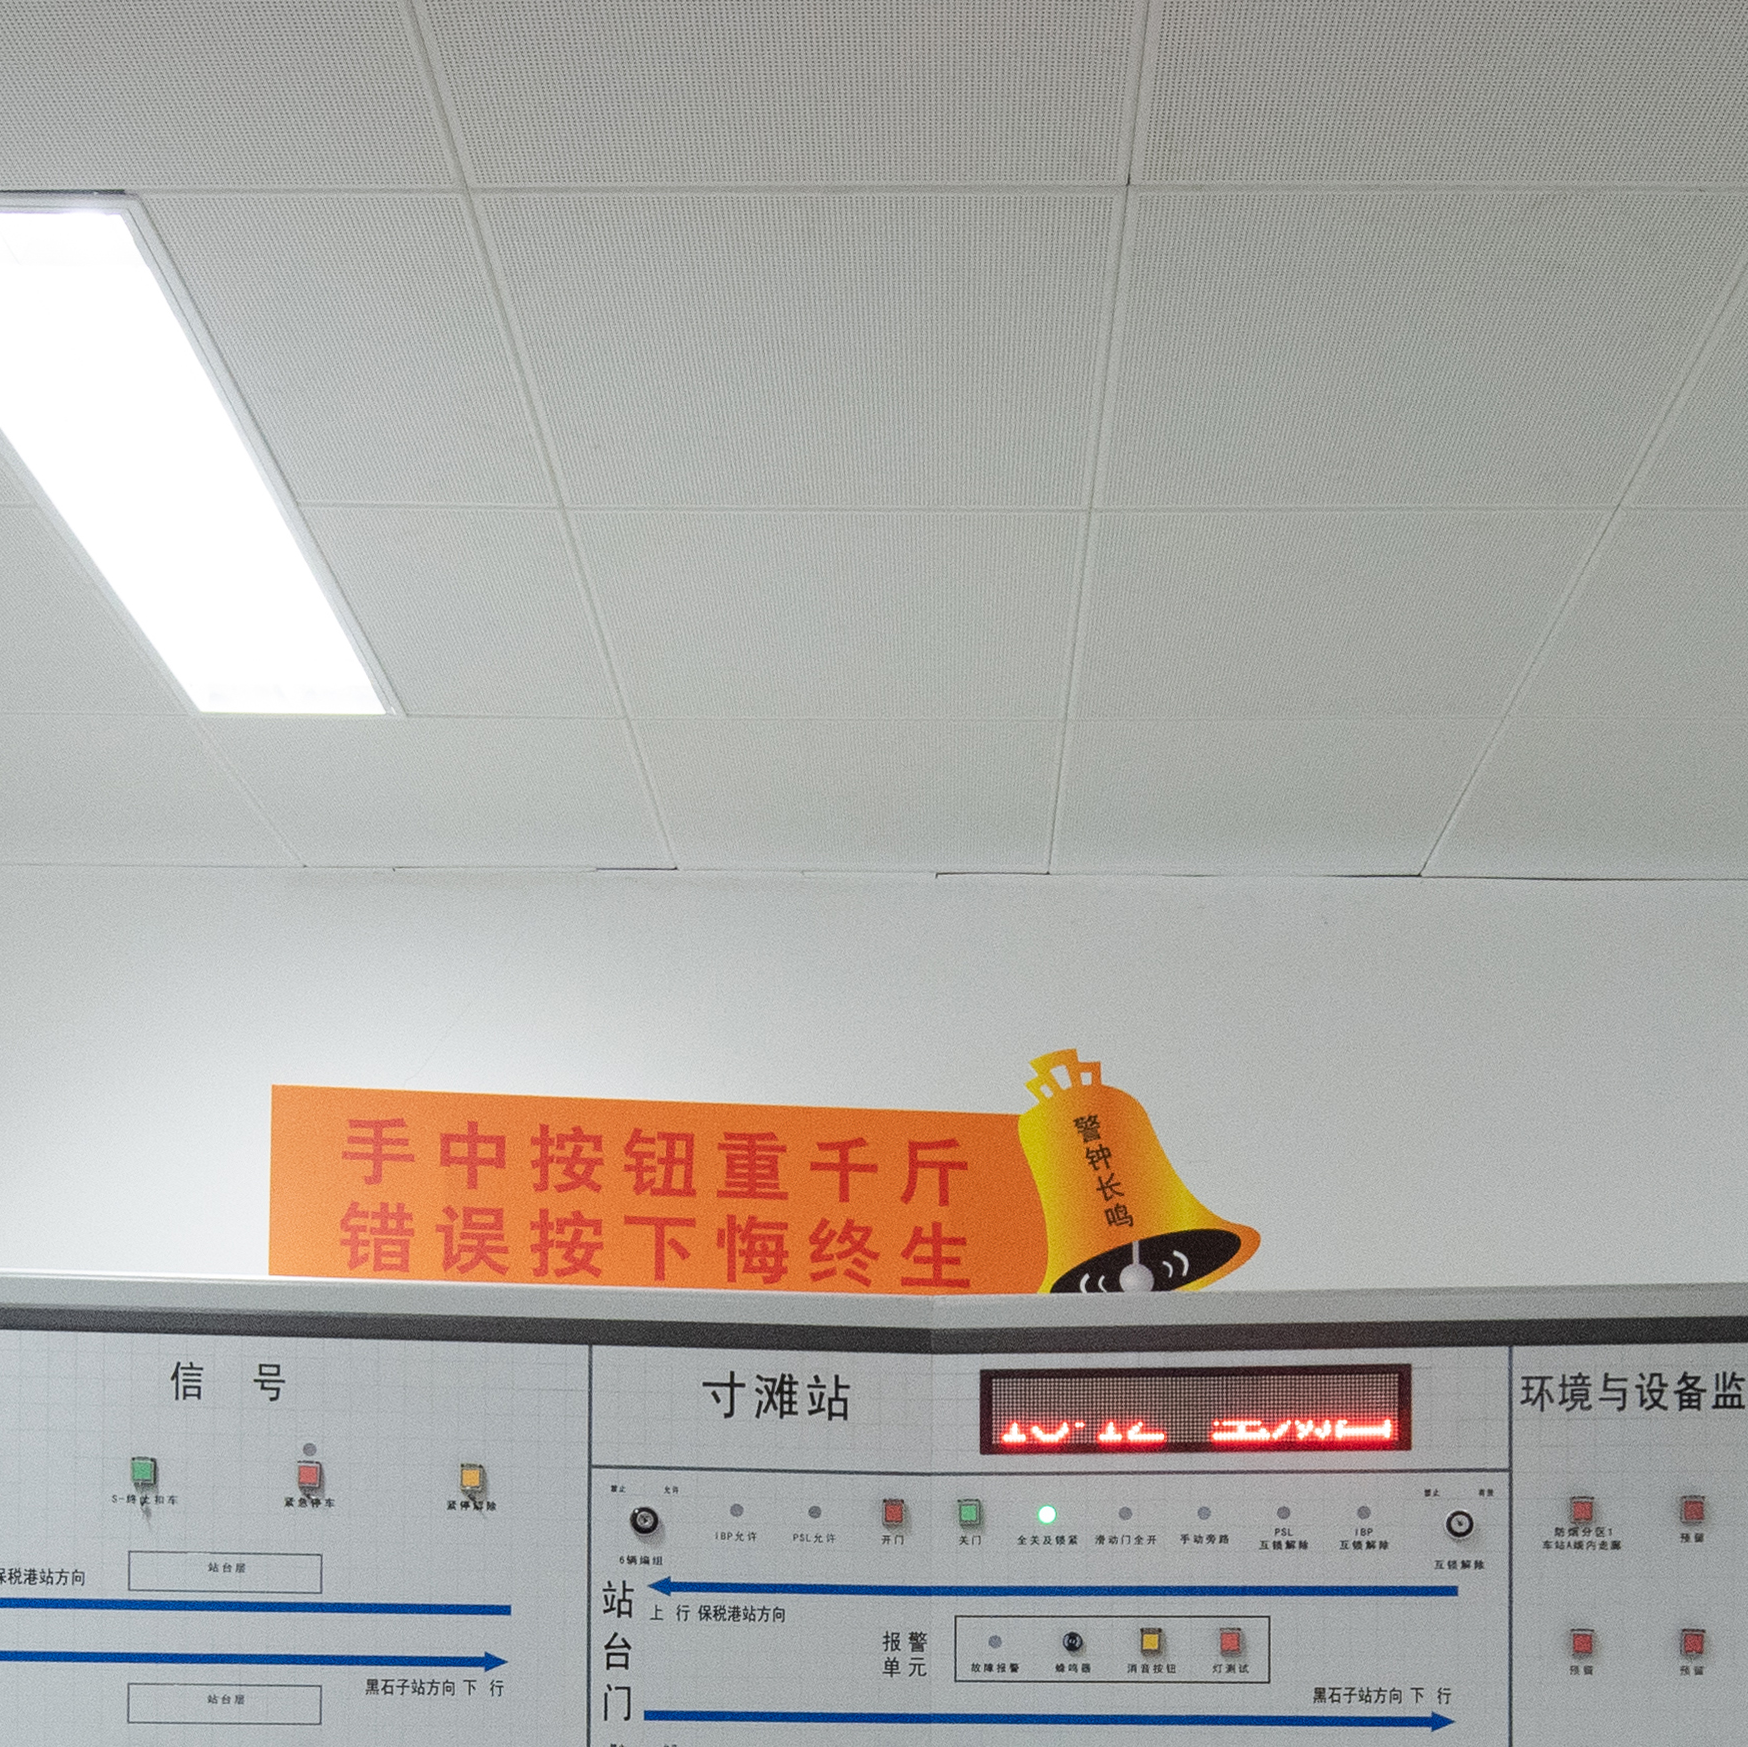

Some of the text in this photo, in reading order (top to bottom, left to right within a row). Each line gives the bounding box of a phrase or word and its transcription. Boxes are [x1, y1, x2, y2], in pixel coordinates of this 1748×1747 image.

[342, 1117, 971, 1207] 手中按钮重千斤
[1075, 1112, 1136, 1232] 警钟长鸣
[340, 1203, 973, 1289] 错误按下悔终生
[703, 1371, 851, 1421] 寸滩站
[601, 1580, 636, 1722] 站台门
